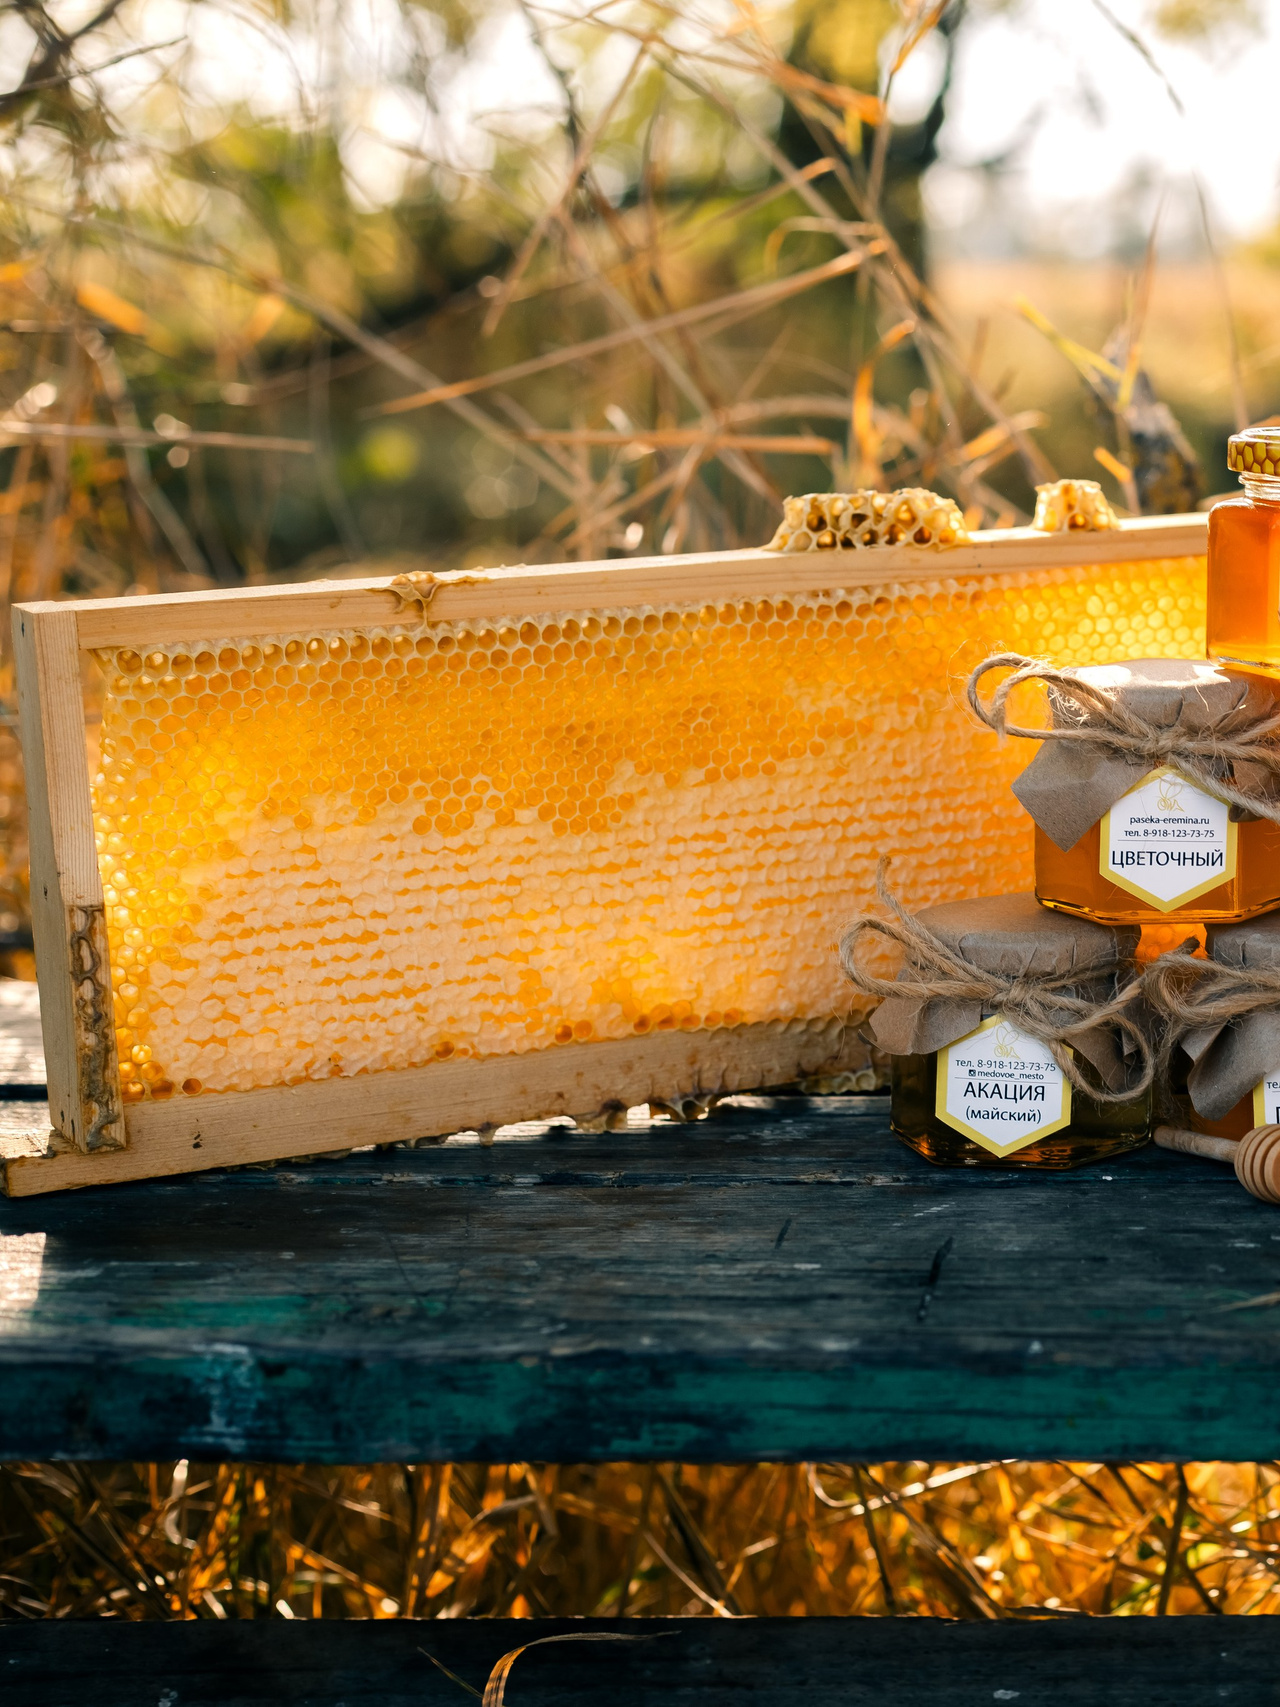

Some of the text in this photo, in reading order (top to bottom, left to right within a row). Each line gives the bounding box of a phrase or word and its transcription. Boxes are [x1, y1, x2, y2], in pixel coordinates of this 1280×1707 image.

[1130, 816, 1210, 825] paseka-eremina.ru
[1143, 829, 1215, 838] 8-918-123-73-75
[1112, 849, 1223, 868] ЦВЕТОЧНЫЙ
[977, 1060, 1056, 1072] 8-918-123-73-75
[978, 1070, 1044, 1080] medovoe_mesto
[963, 1082, 1045, 1103] АКАЦИЯ
[966, 1106, 1042, 1124] (майский)
